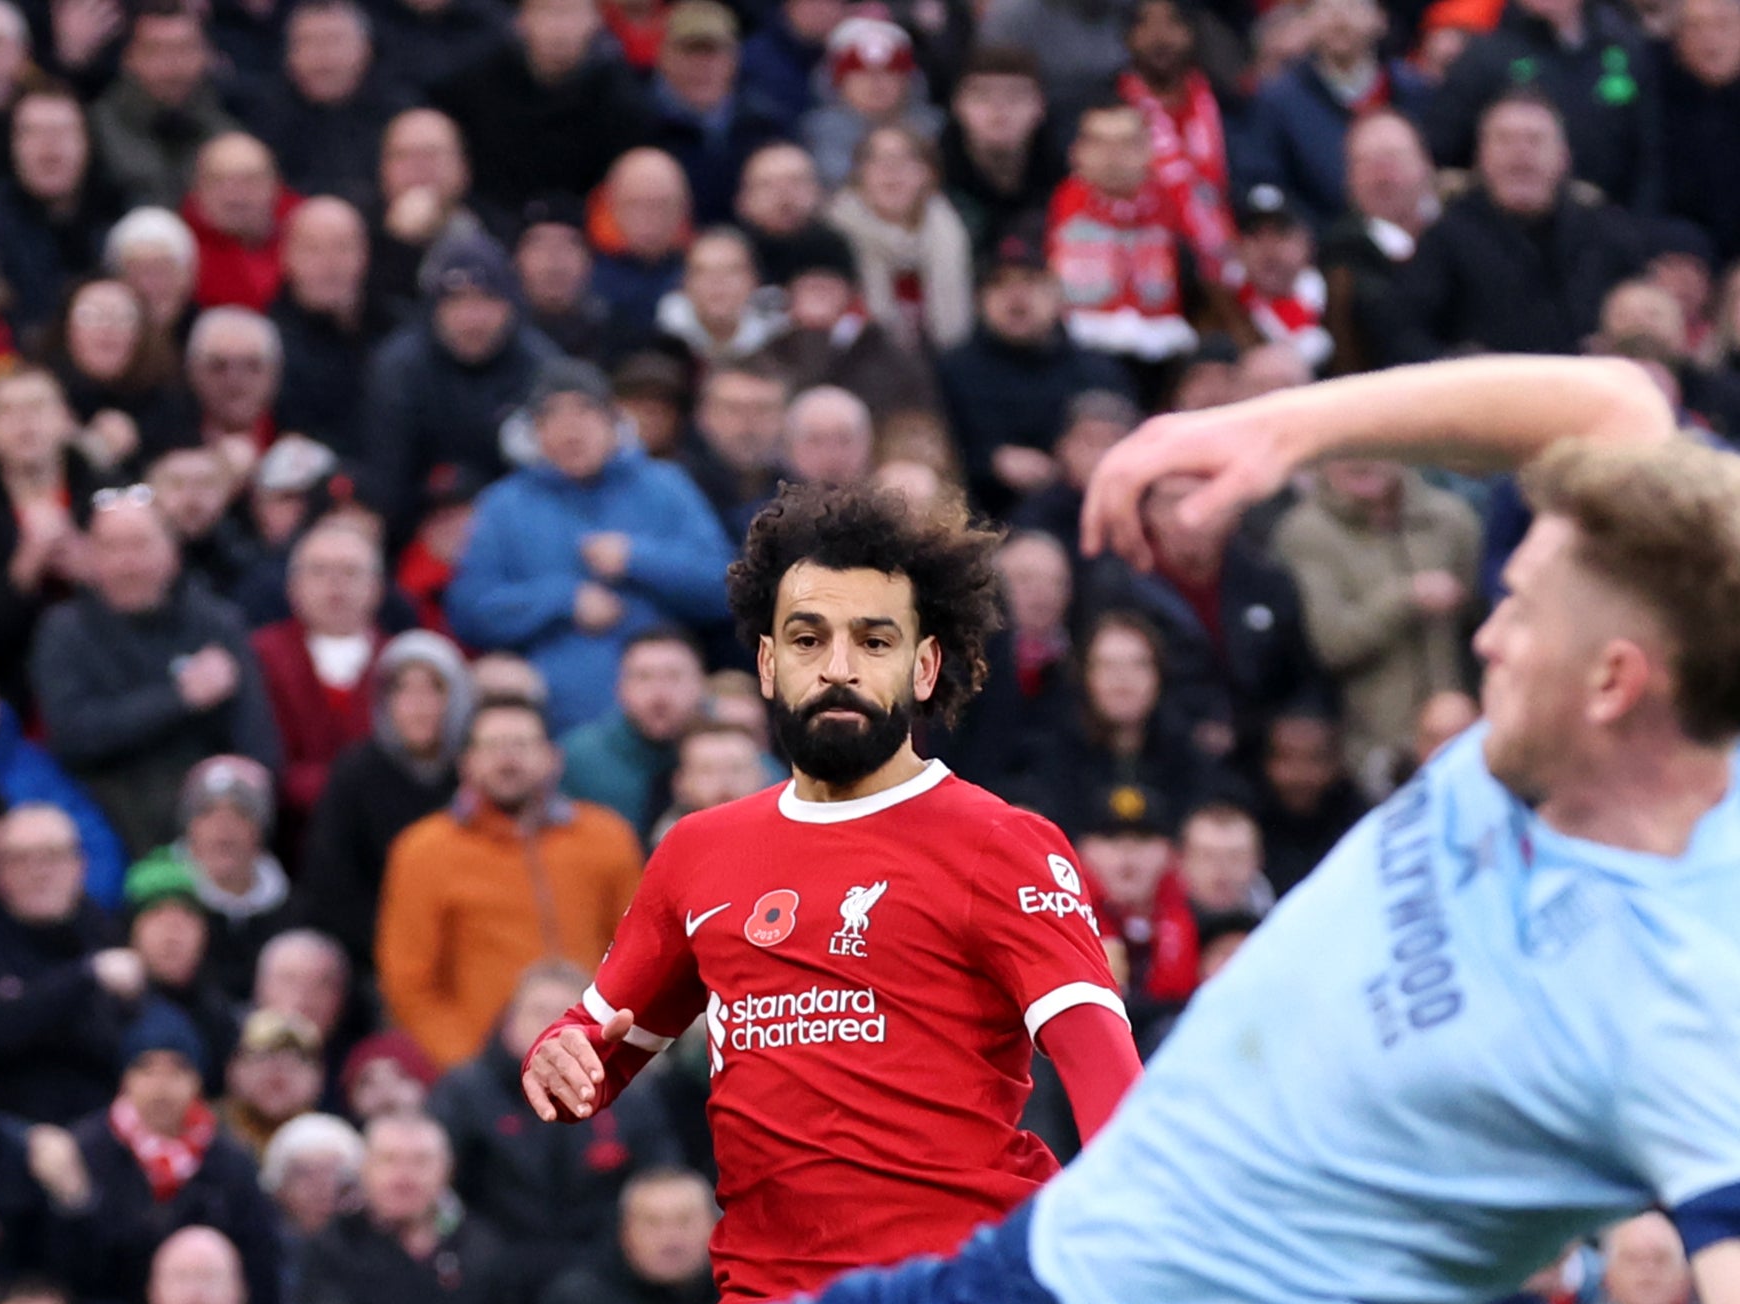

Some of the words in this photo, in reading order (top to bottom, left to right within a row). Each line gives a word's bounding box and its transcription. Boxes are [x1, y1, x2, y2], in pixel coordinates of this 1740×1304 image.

[753, 928, 781, 941] 2023
[828, 937, 868, 957] L.F.C.
[731, 985, 876, 1024] standard
[731, 1013, 886, 1051] chartered
